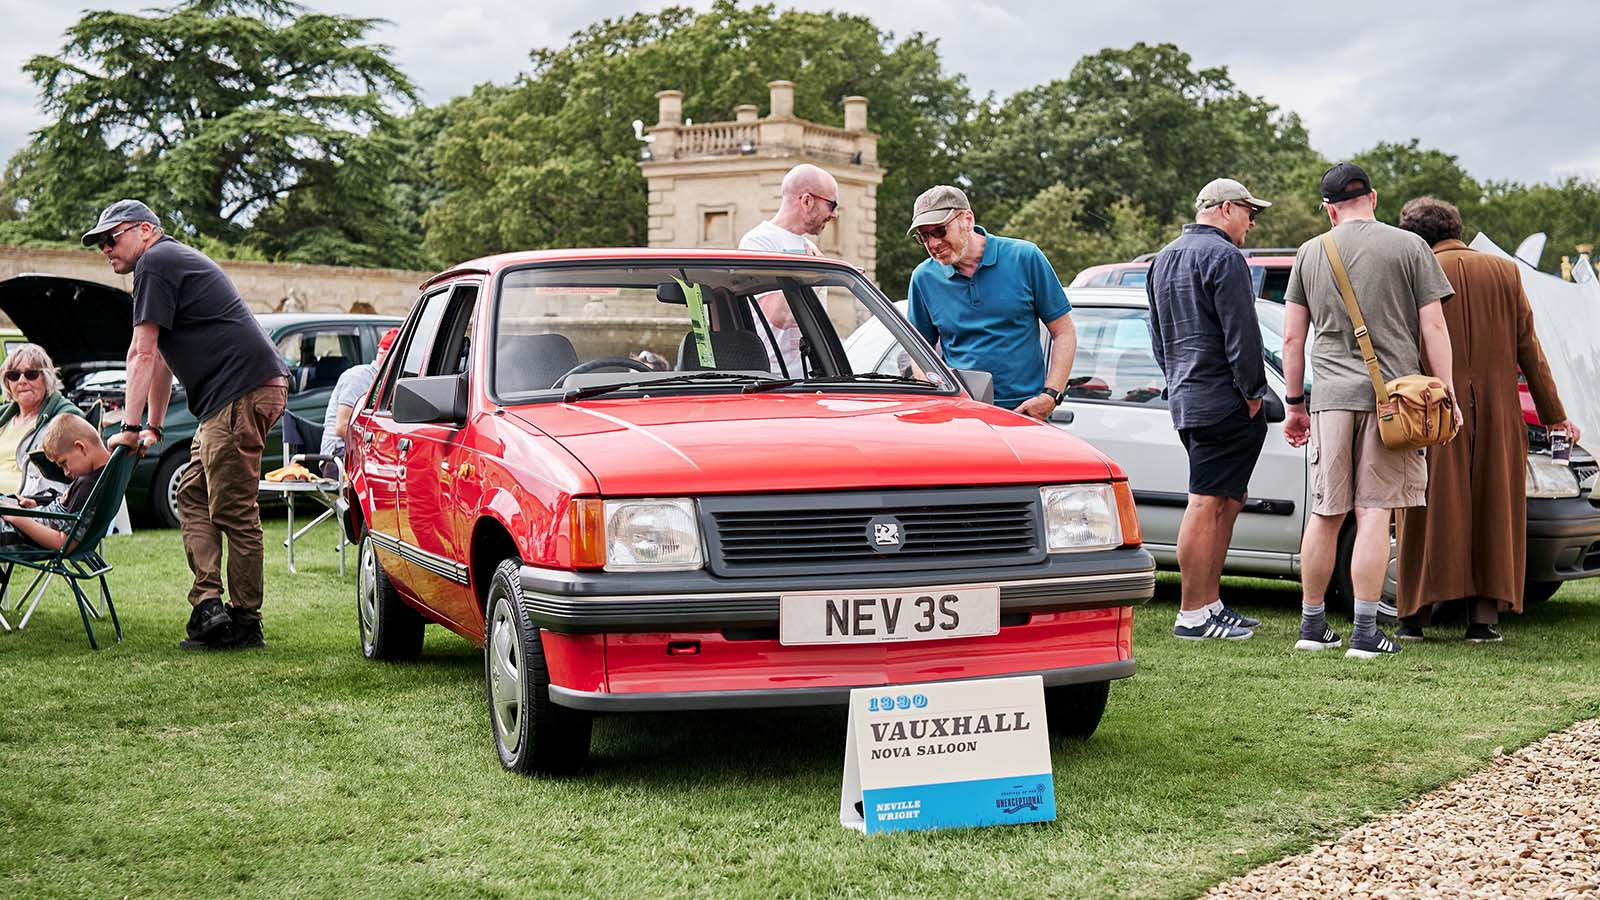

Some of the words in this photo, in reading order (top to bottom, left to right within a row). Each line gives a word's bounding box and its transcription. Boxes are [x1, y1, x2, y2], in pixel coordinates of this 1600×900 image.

[825, 598, 902, 637] NEV
[914, 593, 961, 632] 3S
[868, 694, 928, 712] 1990
[870, 711, 1031, 743] VAUXHALL
[871, 746, 911, 760] NOVA
[917, 741, 977, 756] SALOON
[876, 800, 921, 812] NEVILLE
[996, 795, 1043, 808] UNEXCEPTIONAL
[878, 810, 921, 821] WRIGHT
